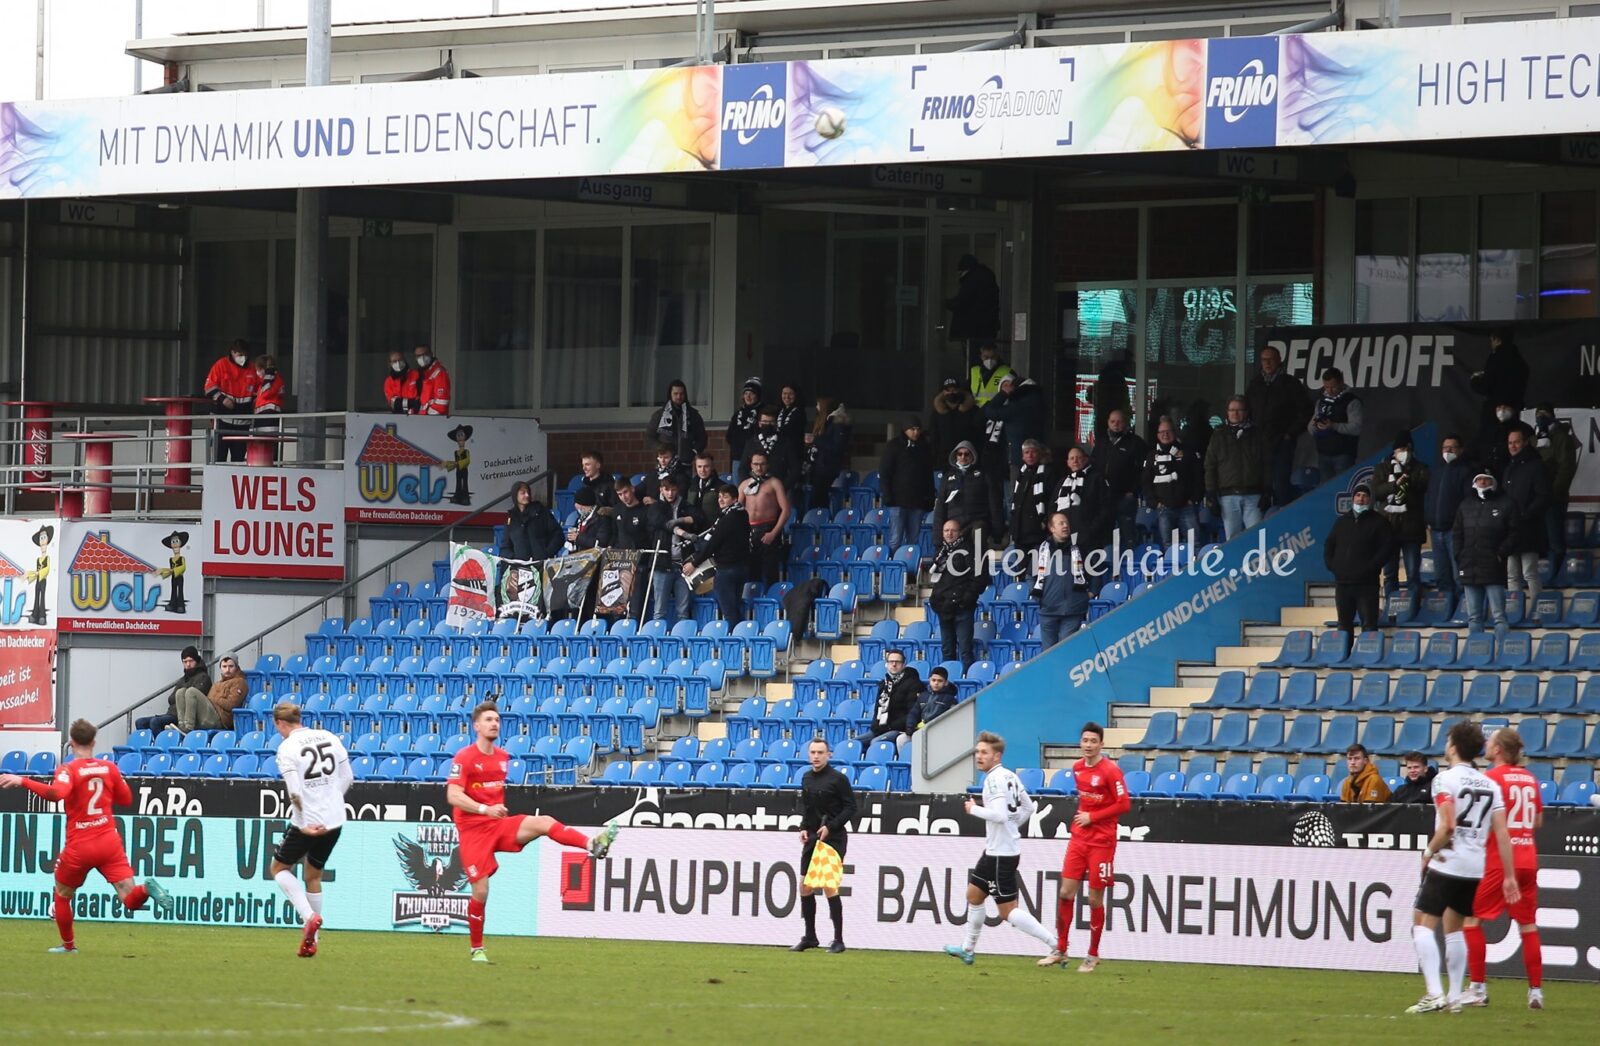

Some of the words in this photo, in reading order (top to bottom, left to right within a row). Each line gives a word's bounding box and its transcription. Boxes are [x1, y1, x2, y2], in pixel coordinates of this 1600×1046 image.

[1207, 73, 1278, 110] FRIMO
[1417, 59, 1506, 107] HIGH
[1520, 53, 1600, 99] TEC
[722, 97, 786, 133] FRIMO
[921, 89, 1063, 121] FRIMOSTADION
[99, 126, 146, 166] MIT
[154, 121, 284, 164] DYNAMIK
[293, 117, 355, 158] UND
[366, 104, 601, 155] LEIDENSCHAFT.
[875, 165, 945, 190] Catering
[1226, 155, 1256, 175] WC
[579, 177, 653, 201] Ausgang
[68, 203, 96, 222] WC
[480, 465, 541, 481] Vertrauenssache!
[484, 456, 522, 468] Dacharbeit
[525, 454, 534, 463] ist
[232, 476, 316, 512] WELS
[358, 463, 448, 504] Wels
[359, 510, 371, 519] Ihre
[373, 510, 409, 520] freundlichen
[411, 511, 443, 521] Dachdecker
[213, 520, 334, 558] LOUNGE
[71, 571, 162, 612] Wels
[72, 620, 85, 629] Ihre
[86, 620, 124, 630] freundlichen
[126, 621, 160, 631] Dachdecker
[8, 635, 46, 648] Dachdecker
[19, 665, 31, 682] ist
[300, 741, 336, 780] 25
[87, 778, 104, 816] 2
[1456, 787, 1494, 829] 27
[1507, 784, 1537, 829] 26
[417, 825, 460, 842] NINJA
[427, 842, 450, 853] AREA
[1098, 862, 1111, 878] 31
[603, 857, 855, 918] HAUPHO
[399, 897, 469, 917] THUNDERBIR
